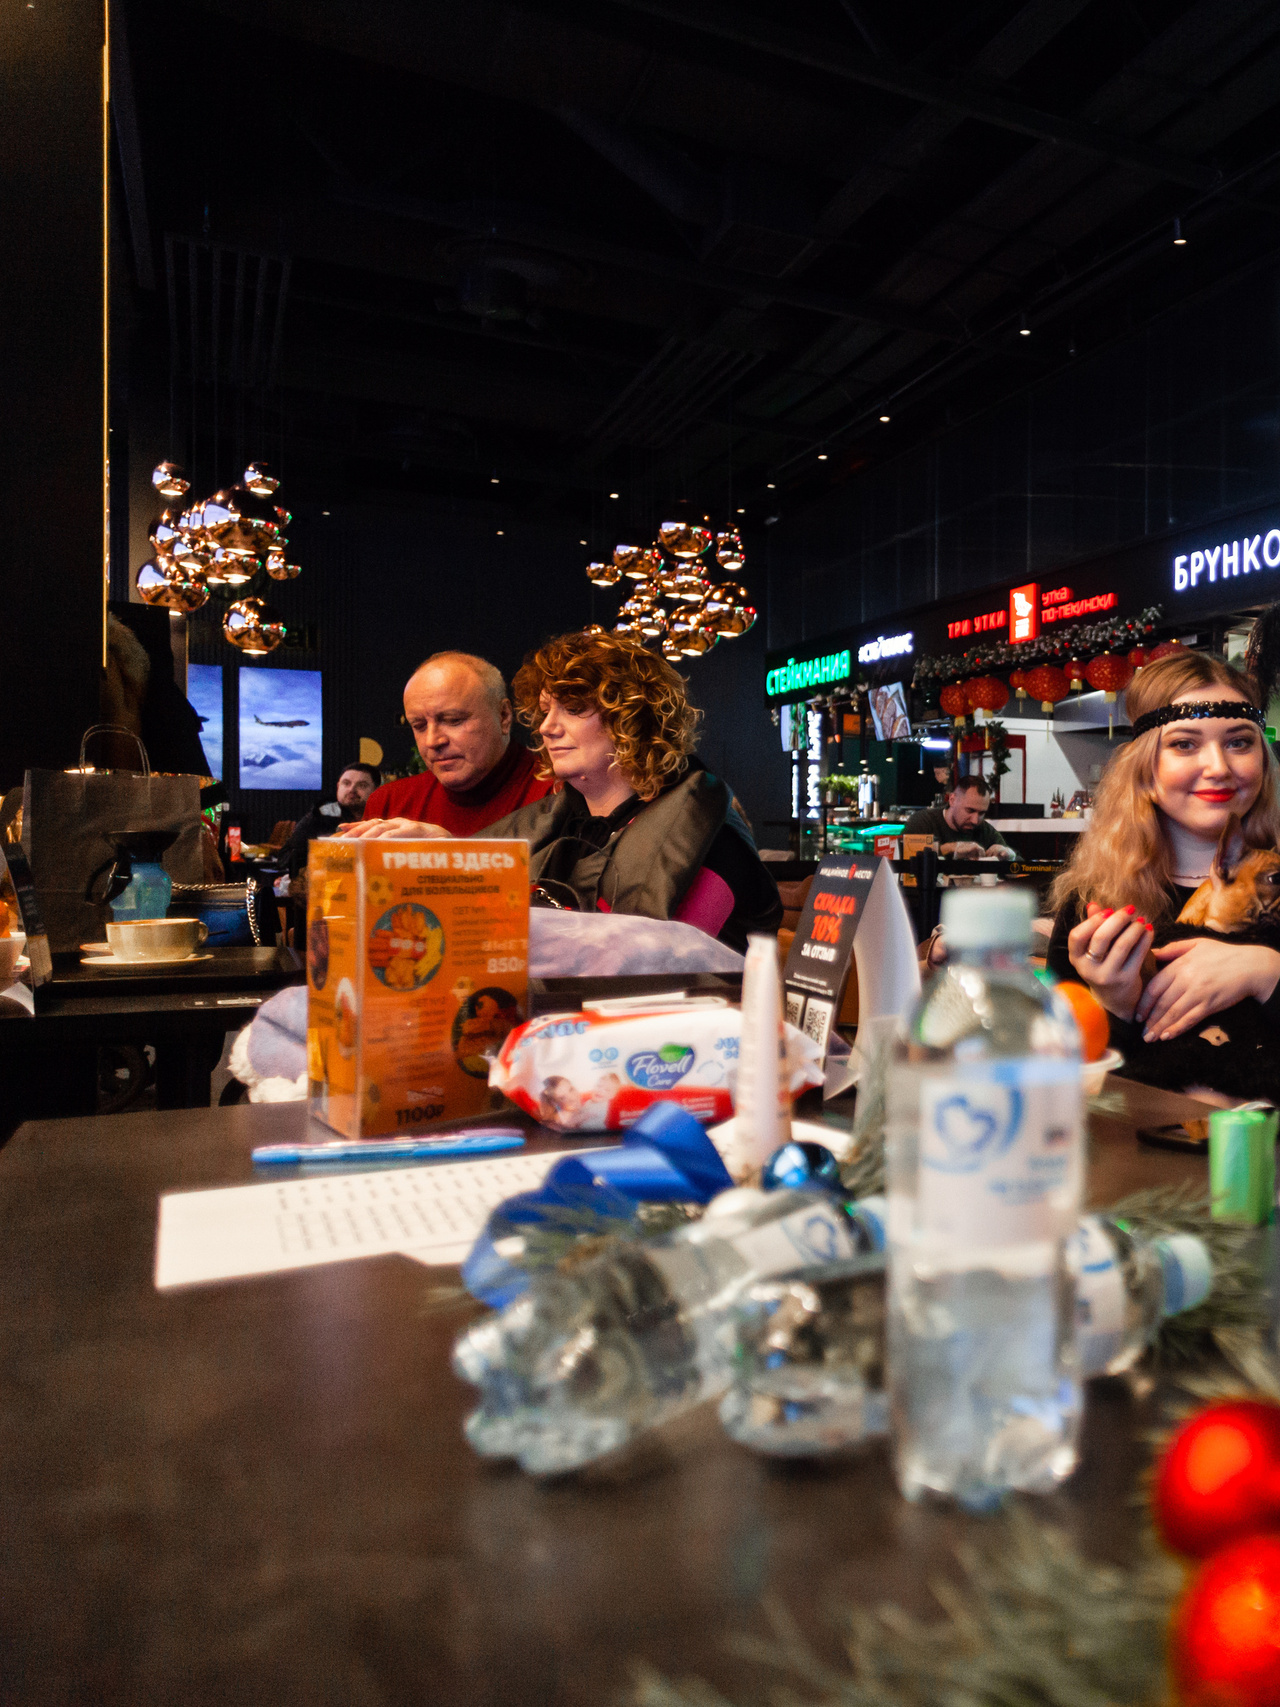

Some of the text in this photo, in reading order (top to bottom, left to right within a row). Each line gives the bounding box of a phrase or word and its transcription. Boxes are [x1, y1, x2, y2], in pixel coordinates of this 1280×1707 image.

[947, 618, 972, 639] ТРИ
[974, 609, 1007, 633] УТКИ
[766, 649, 850, 696] СТЕЙКМАНИЯ
[382, 851, 516, 872] ГРЕКИ ЗДЕСЬ
[813, 891, 857, 915] СКИДКА
[810, 915, 843, 944] 10%
[631, 1053, 693, 1077] Flovell
